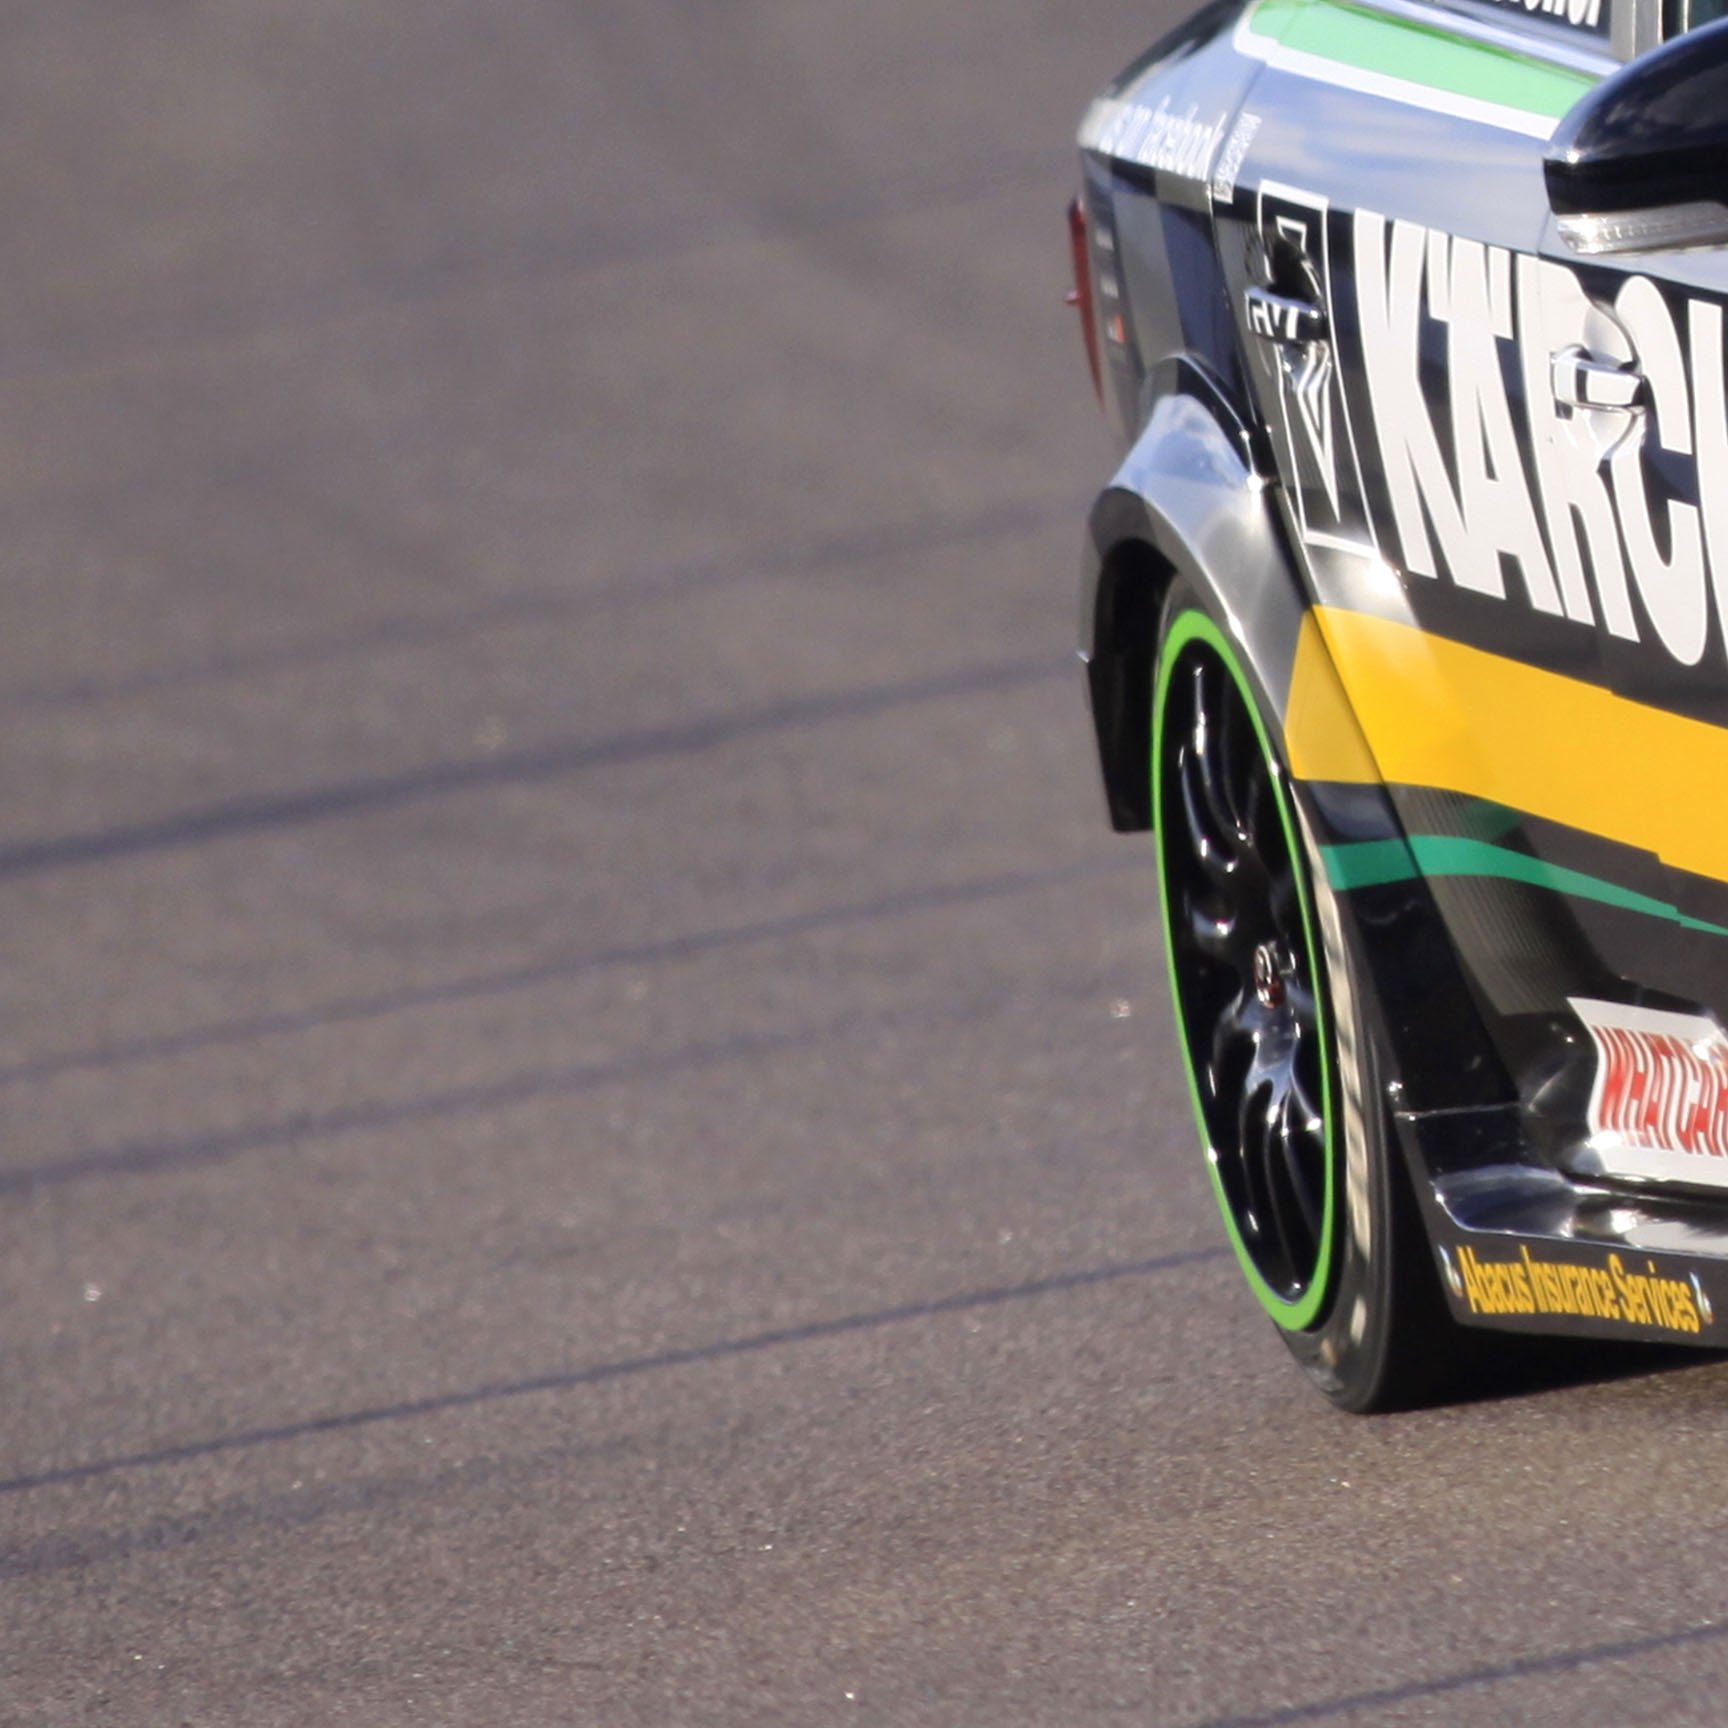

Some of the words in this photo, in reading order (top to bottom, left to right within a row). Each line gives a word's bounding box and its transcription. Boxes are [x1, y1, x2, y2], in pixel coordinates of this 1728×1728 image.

[1455, 1244, 1530, 1315] Abacus
[1521, 1245, 1616, 1322] Insurance
[1607, 1251, 1701, 1334] Services
